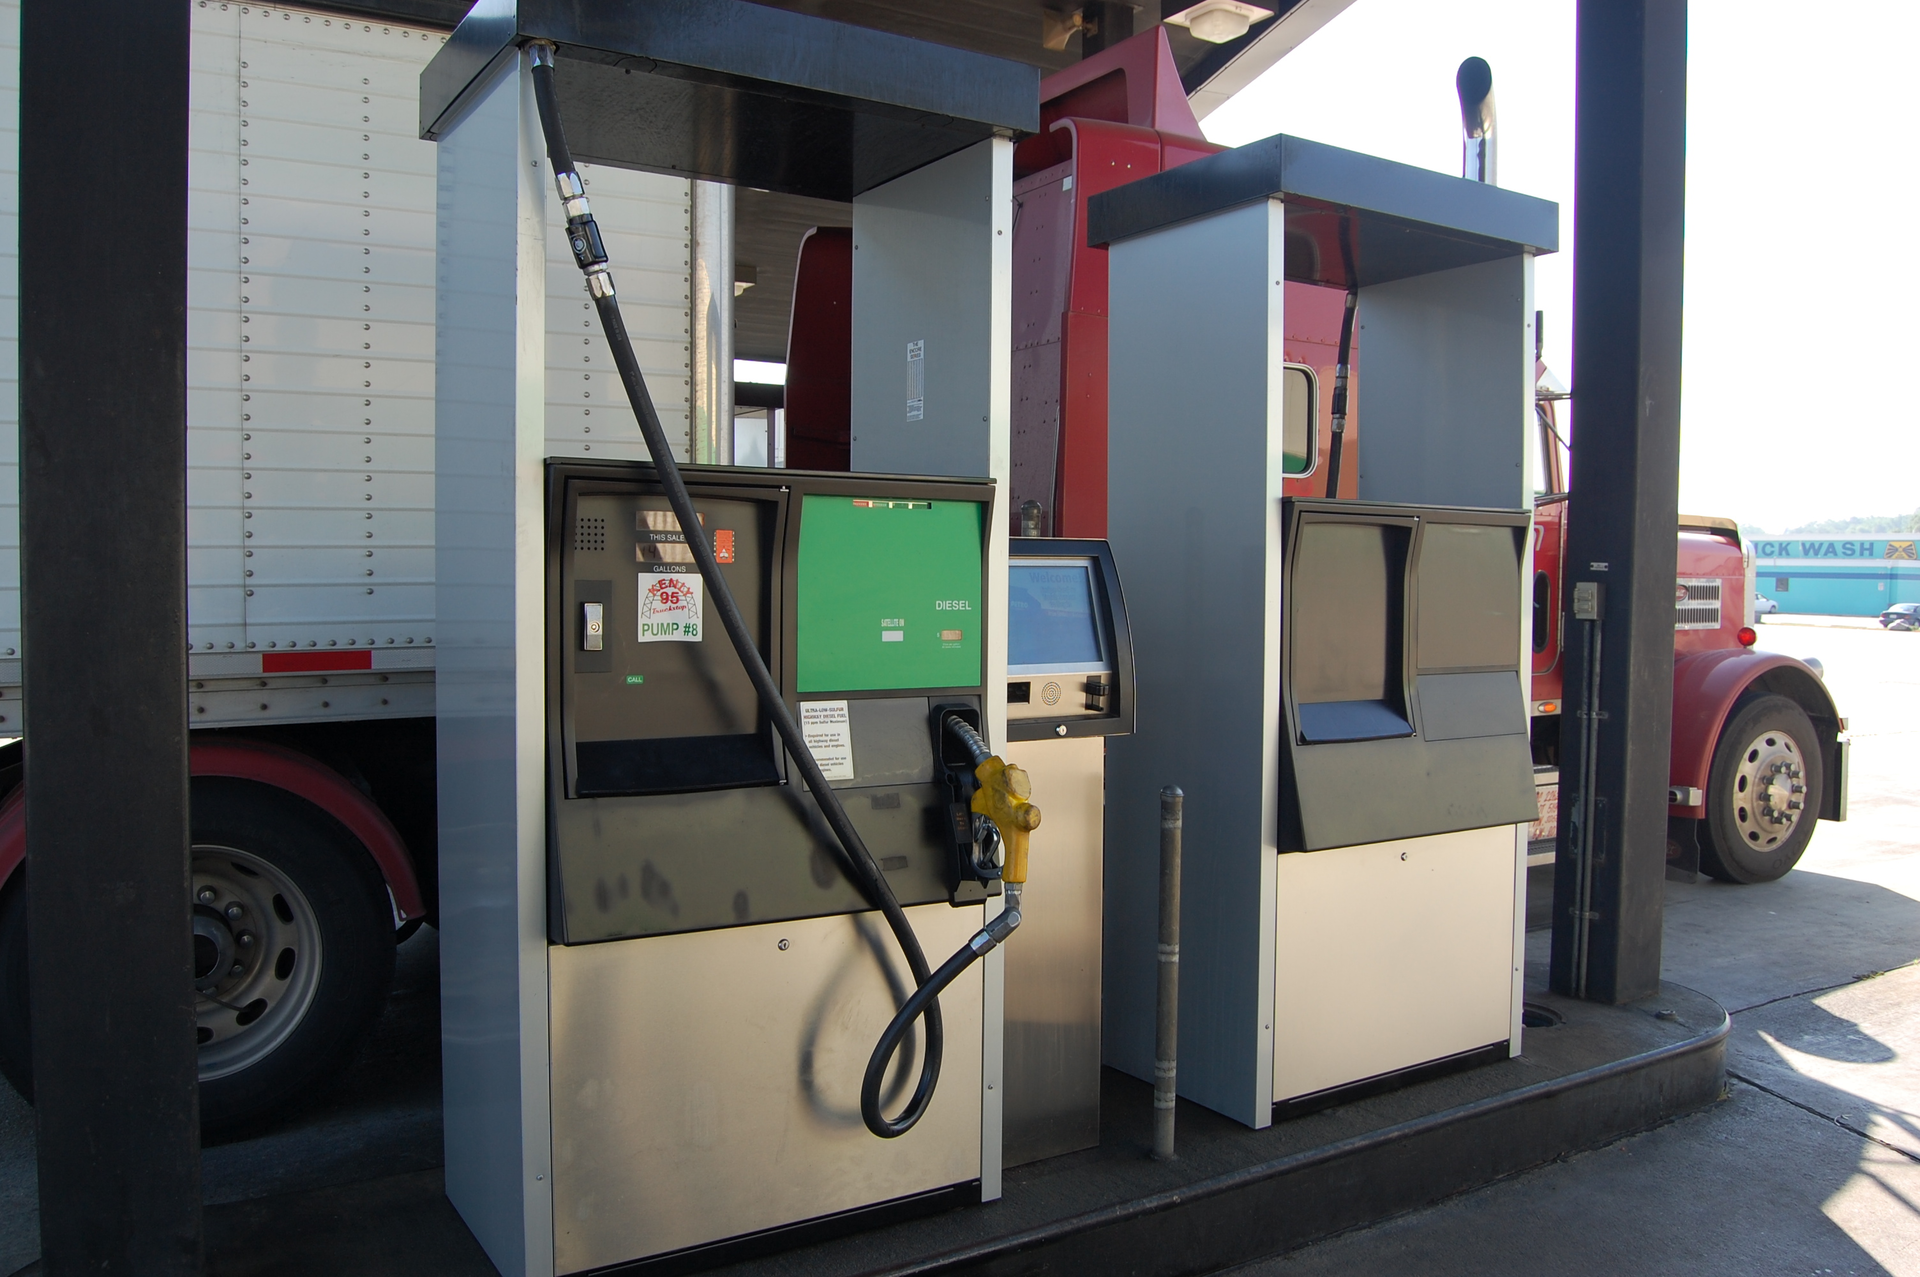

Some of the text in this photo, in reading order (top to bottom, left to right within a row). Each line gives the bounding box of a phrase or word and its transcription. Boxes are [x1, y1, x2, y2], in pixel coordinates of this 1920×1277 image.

[649, 533, 666, 541] THIS
[1800, 542, 1874, 557] WASH
[648, 577, 694, 597] KENLY
[660, 591, 680, 604] 95
[652, 604, 687, 614] Truckstop
[935, 600, 972, 610] DIESEL
[881, 618, 899, 627] SATELLITE
[642, 622, 698, 637] PUMP #8
